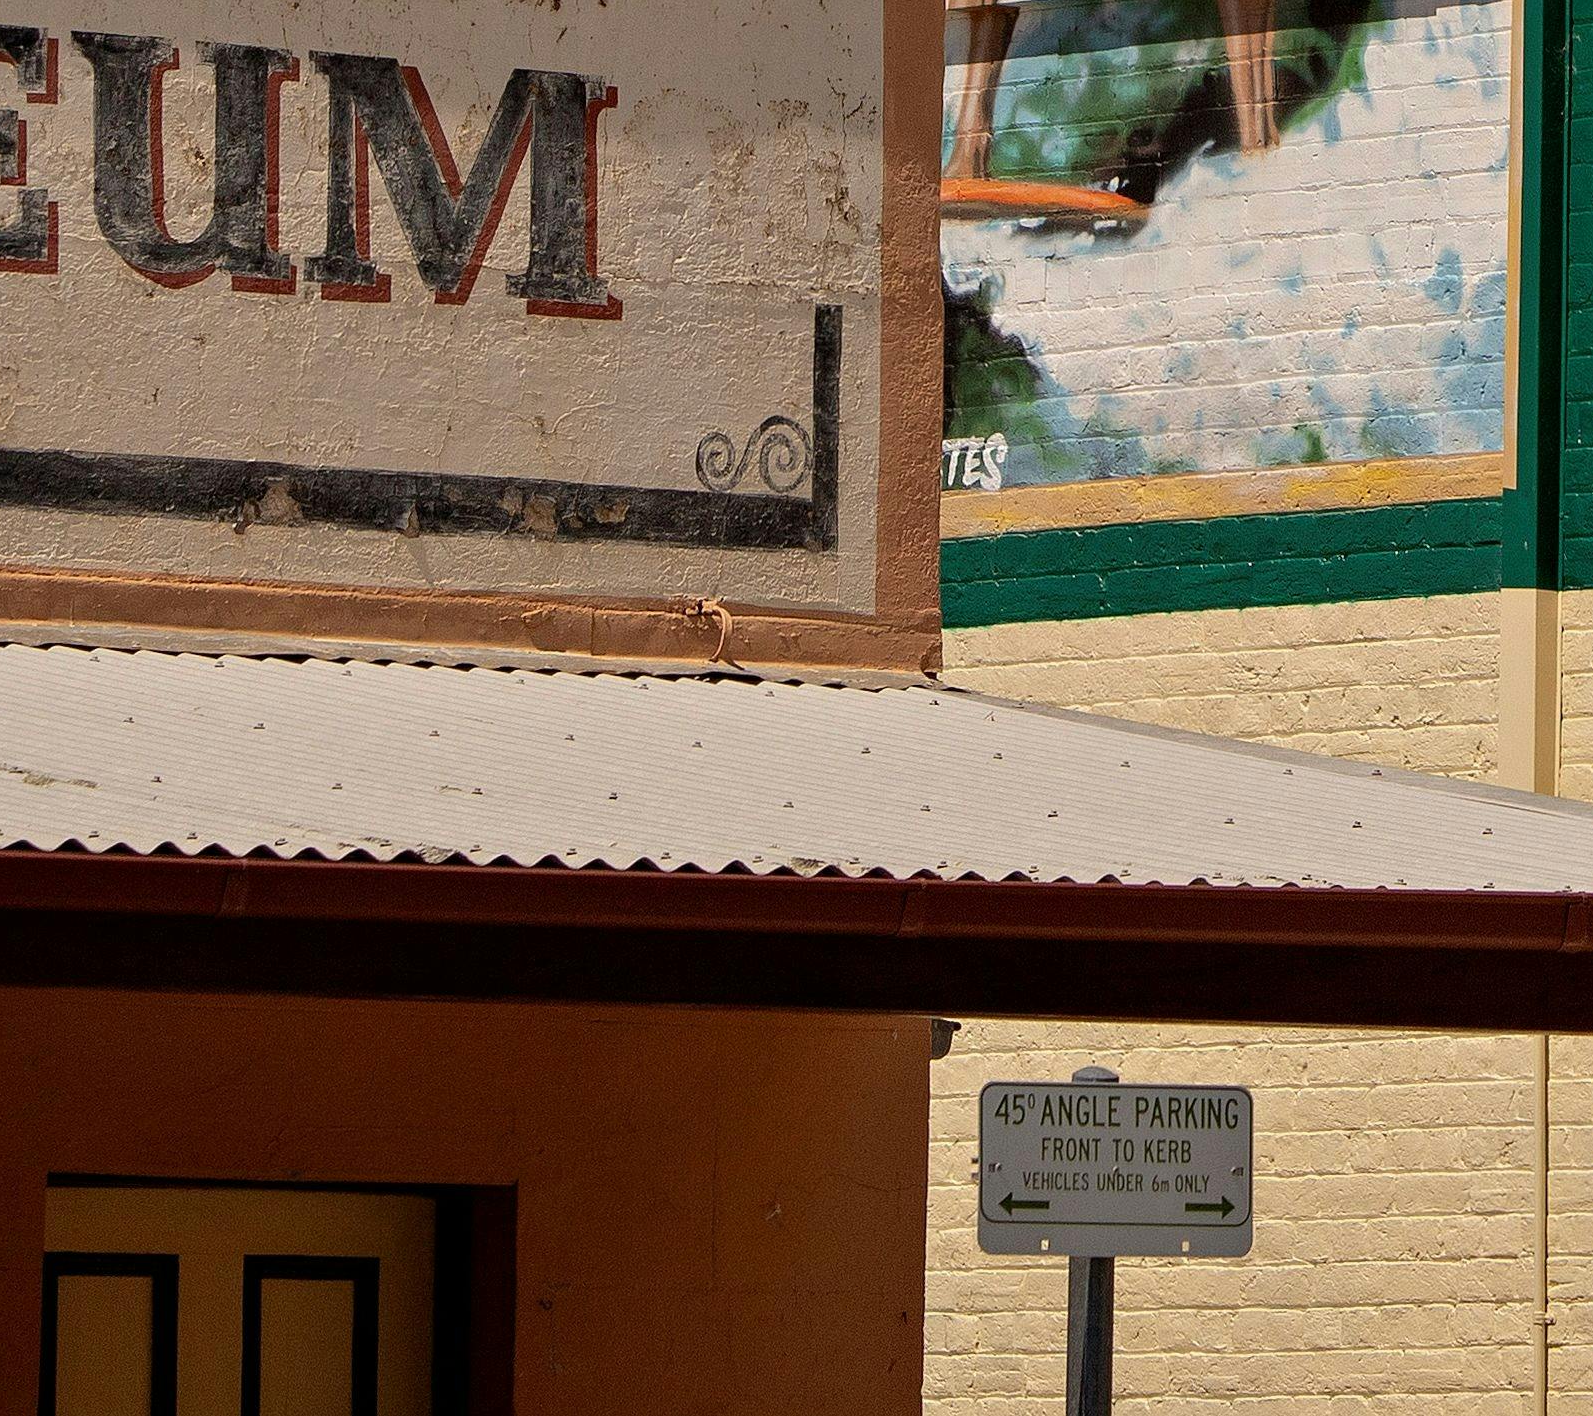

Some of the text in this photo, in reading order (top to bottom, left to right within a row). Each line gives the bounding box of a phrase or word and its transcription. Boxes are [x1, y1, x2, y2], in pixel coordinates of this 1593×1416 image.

[942, 433, 1007, 491] TES
[1040, 1094, 1121, 1127] ANGLE
[1135, 1096, 1239, 1129] PARKING
[1041, 1137, 1192, 1164] FRONT TO KERB
[1023, 1171, 1210, 1193] VEHICLES UNDER 6m ONLY
